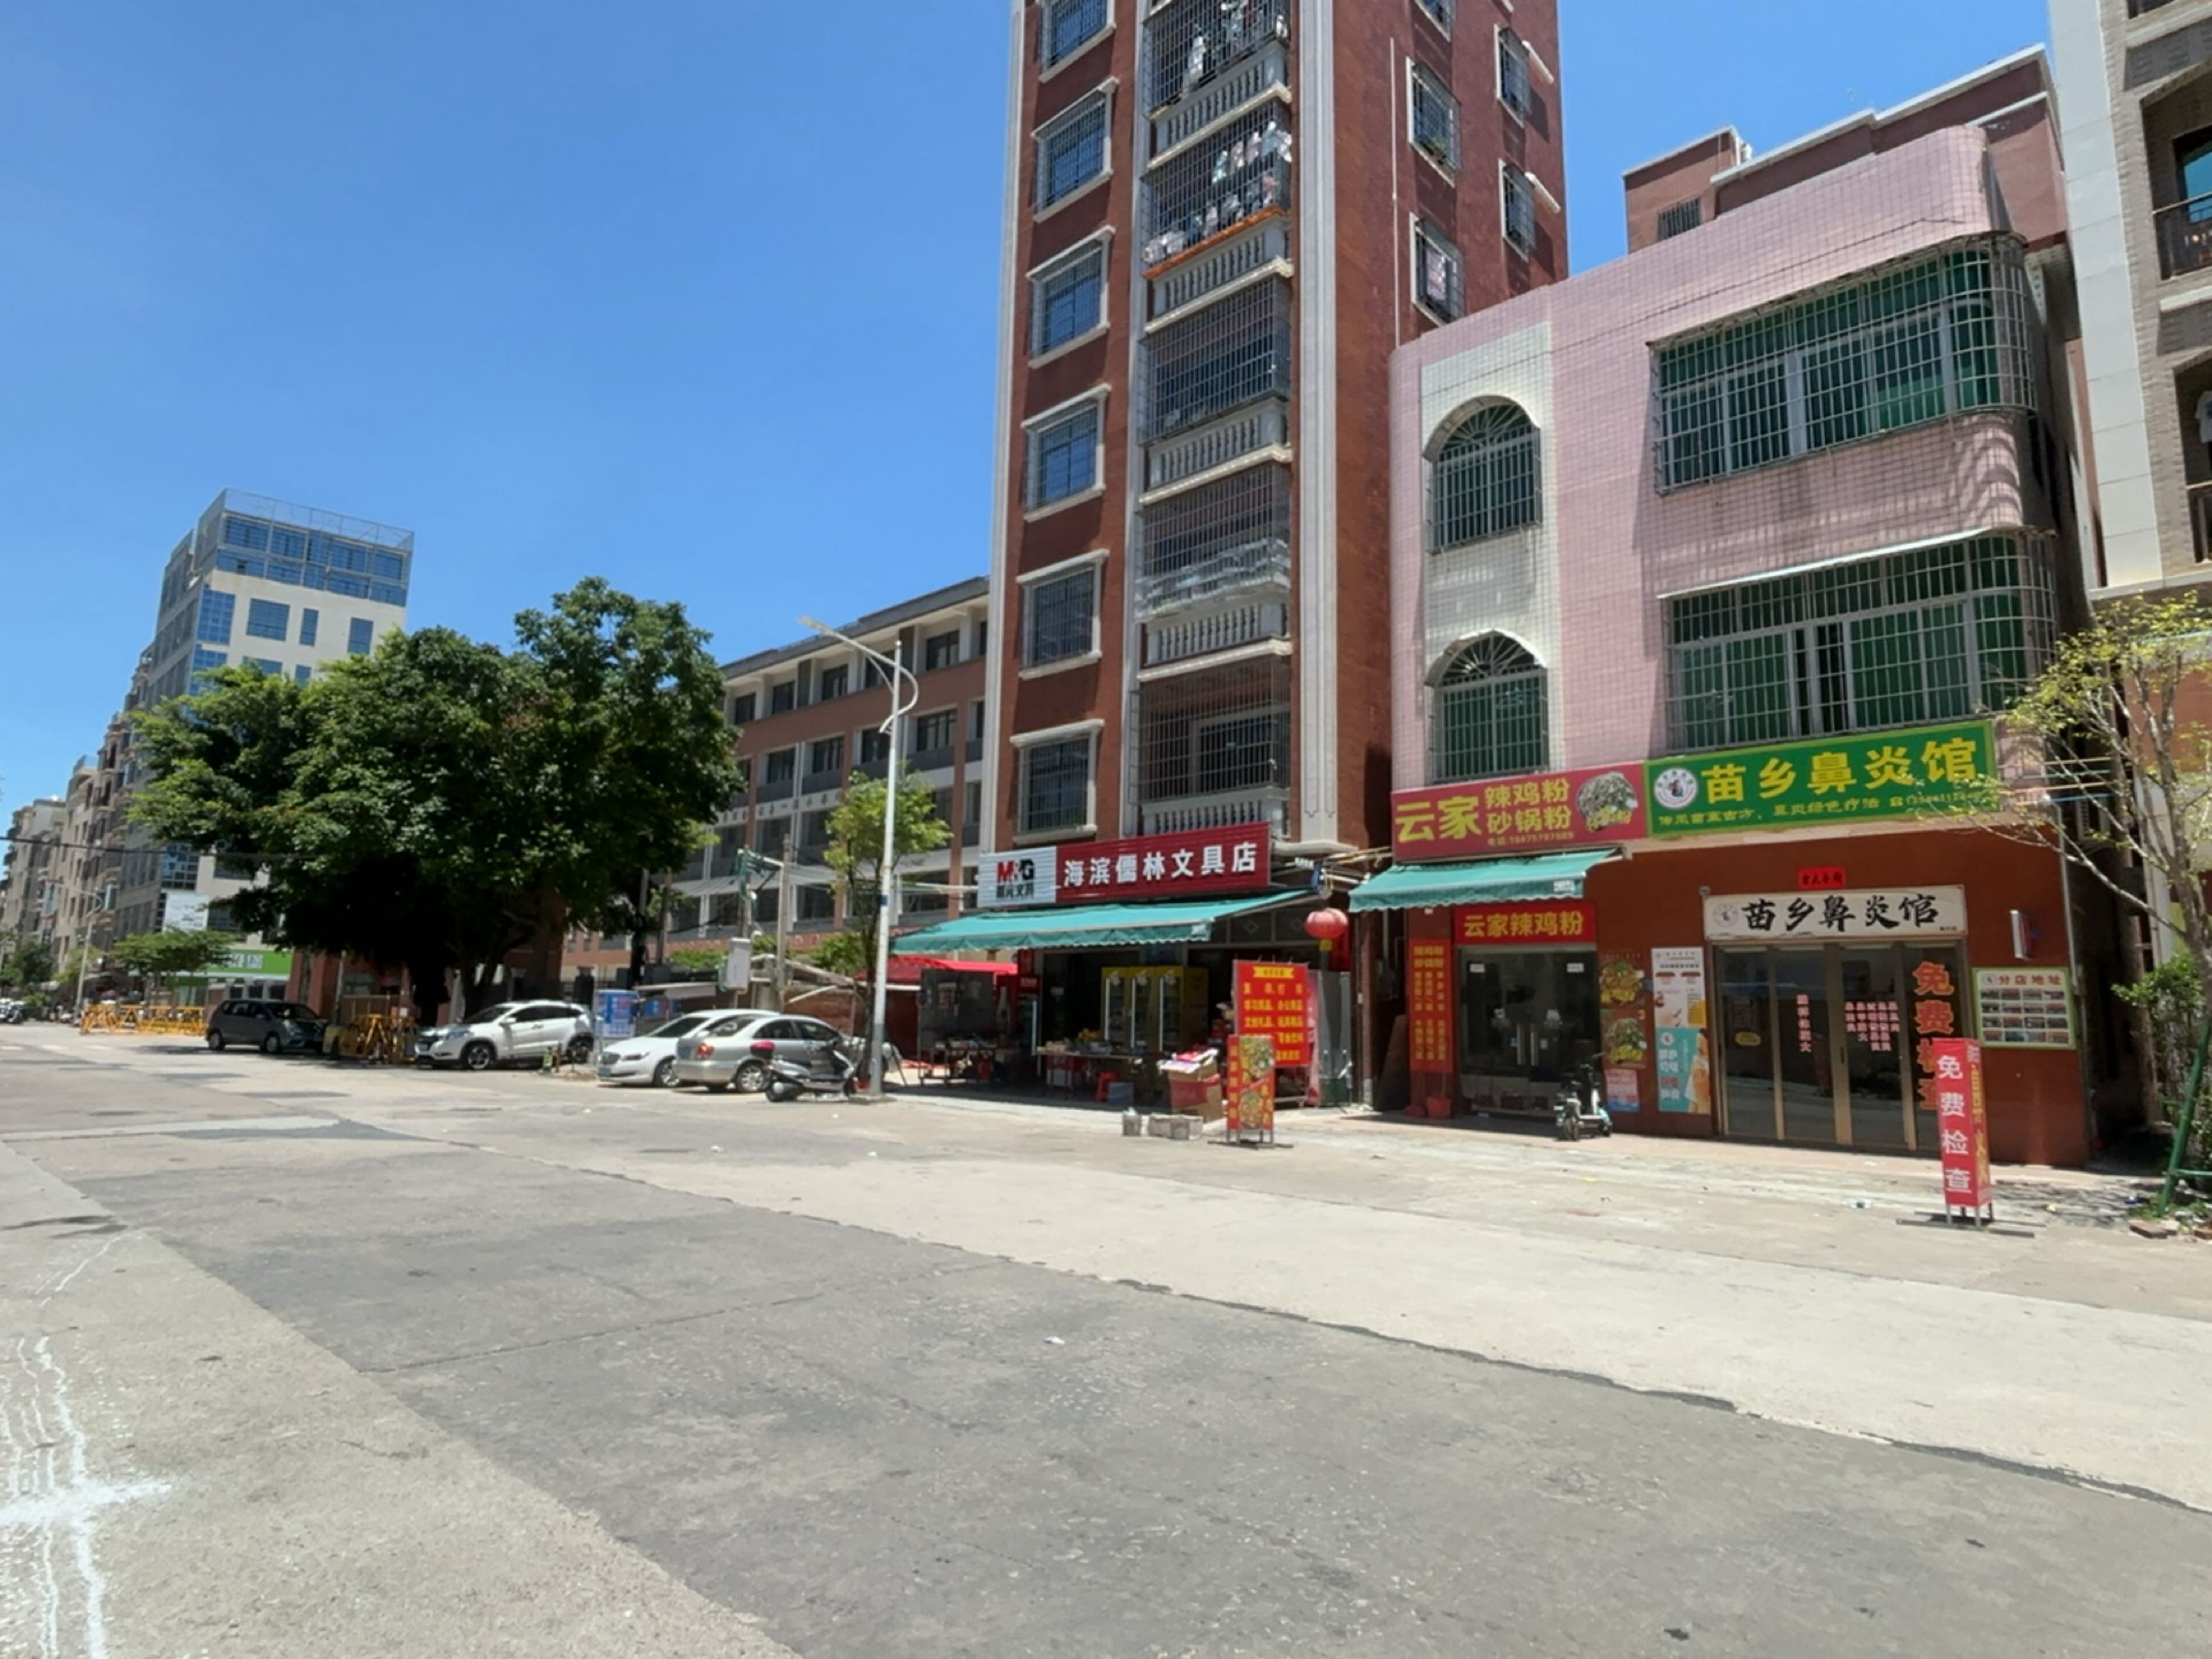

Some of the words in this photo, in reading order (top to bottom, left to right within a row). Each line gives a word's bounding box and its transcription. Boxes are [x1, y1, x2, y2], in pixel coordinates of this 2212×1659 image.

[1701, 737, 1976, 803] 苗乡鼻炎馆
[1484, 778, 1570, 808] 辣鸡粉
[1395, 795, 1482, 844] 云家
[1486, 805, 1572, 835] 砂锅粉
[1064, 842, 1257, 887] 海滨儒林文具店
[1464, 911, 1584, 938] 云家辣鸡粉
[1741, 893, 1939, 932] 苗乡鼻炎馆
[1937, 1055, 1972, 1193] 免费检查
